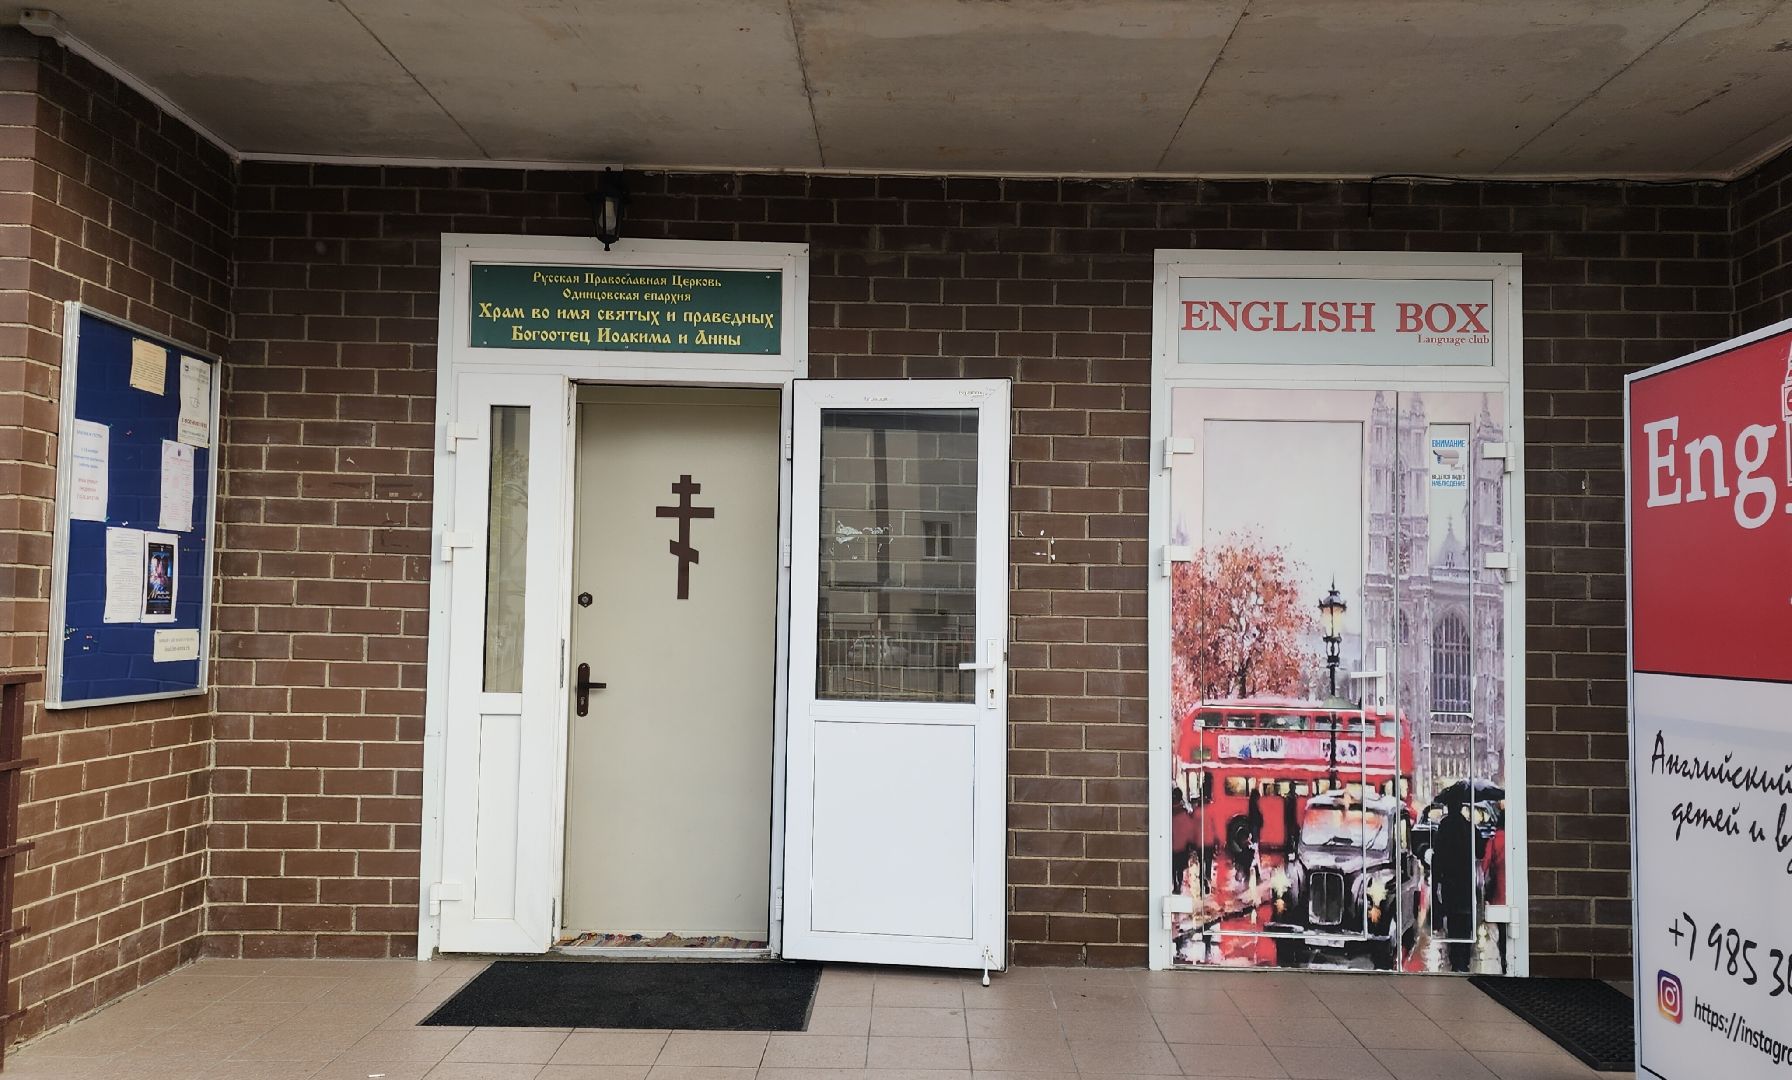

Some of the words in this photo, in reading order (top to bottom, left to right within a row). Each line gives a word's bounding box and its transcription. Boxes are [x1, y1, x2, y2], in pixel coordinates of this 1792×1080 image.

[532, 271, 580, 286] Русская
[584, 272, 667, 287] Православная
[672, 275, 722, 289] Церковь
[562, 287, 640, 301] Одинцовская
[644, 292, 692, 304] епархия
[478, 302, 525, 322] Храм
[531, 308, 550, 319] во
[557, 308, 590, 320] имя
[597, 309, 660, 326] святых
[666, 311, 676, 322] и
[683, 312, 774, 329] праведных
[1181, 301, 1376, 332] ENGLISH
[1395, 302, 1490, 333] BOX
[511, 325, 591, 346] Богоотец
[597, 327, 671, 344] Иоакима
[678, 333, 688, 344] и
[695, 330, 742, 346] Анны
[1418, 334, 1466, 346] Language
[1468, 334, 1490, 344] club
[1431, 439, 1466, 448] ВНИМАНИЕ
[1643, 415, 1792, 529] Eng
[1651, 729, 1792, 796] Английский
[1671, 801, 1741, 841] детей
[1748, 820, 1766, 843] и
[1668, 911, 1697, 961] +7
[1707, 922, 1758, 985] 985
